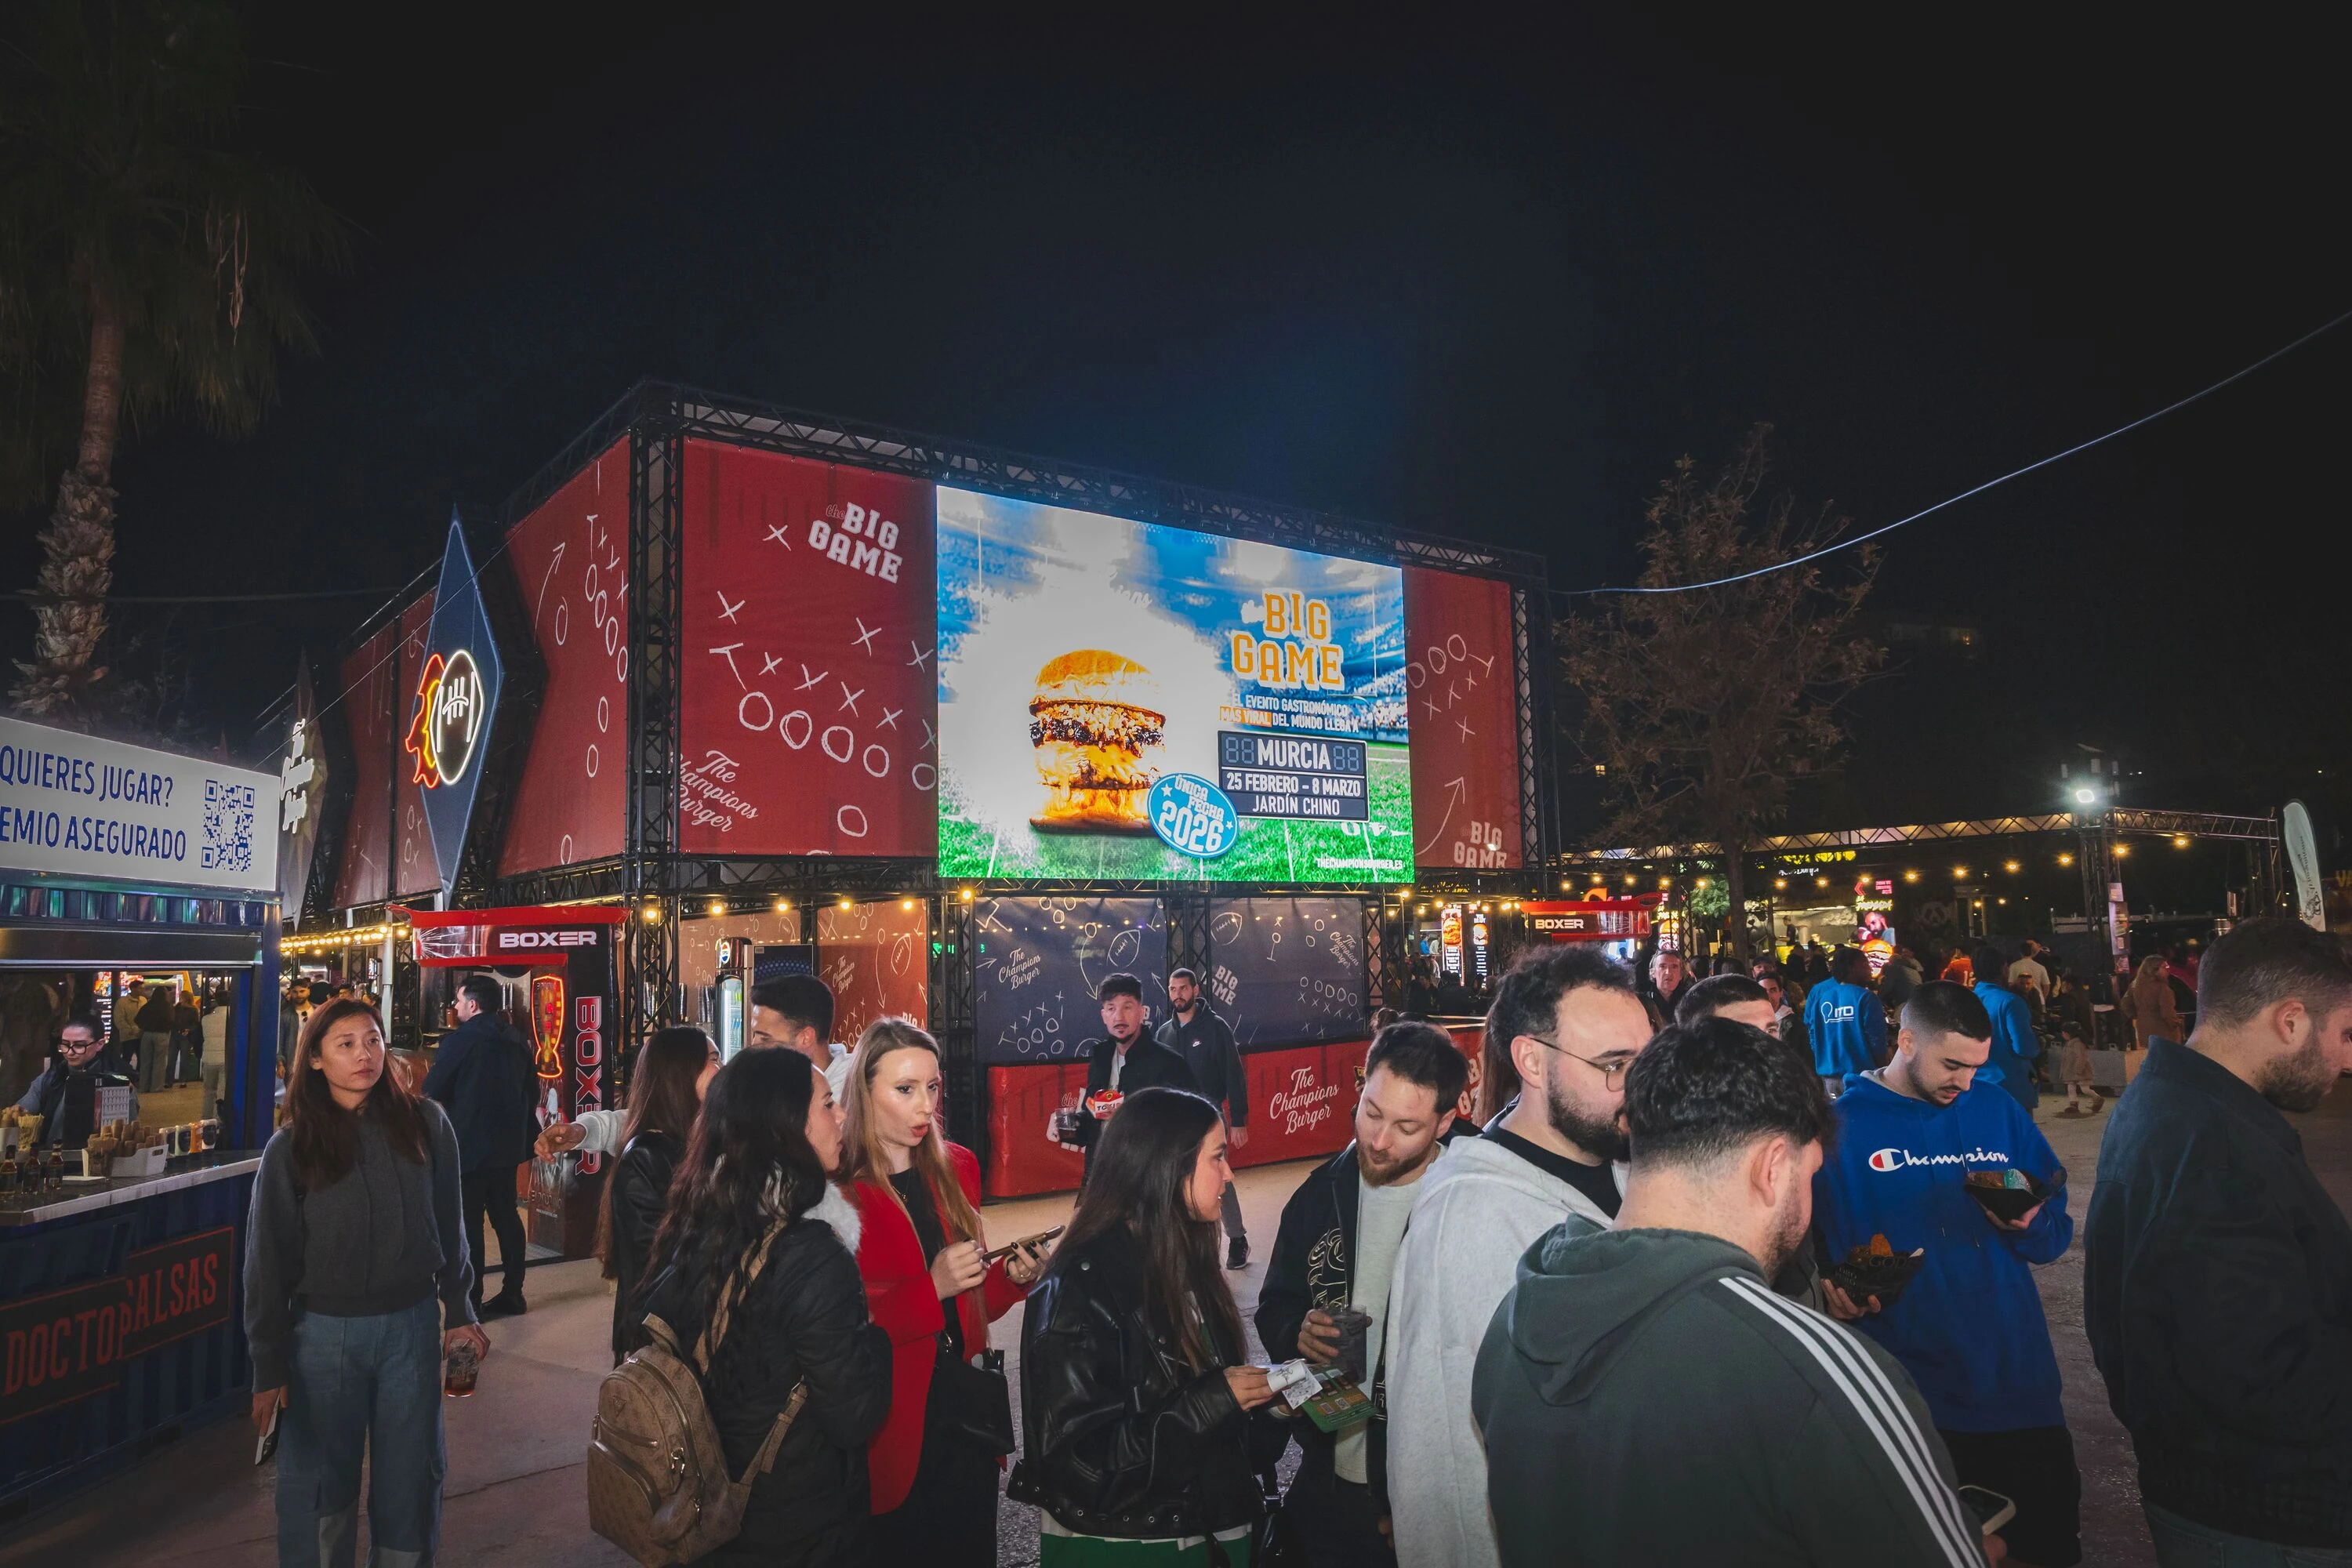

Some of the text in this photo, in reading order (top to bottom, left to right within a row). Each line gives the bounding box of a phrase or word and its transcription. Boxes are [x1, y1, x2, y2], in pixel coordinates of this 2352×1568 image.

[841, 502, 899, 550] BIG
[808, 520, 902, 583] GAME
[1263, 591, 1330, 643] BIG
[1232, 632, 1344, 690] GAME
[1245, 695, 1279, 711] EVENTO
[1272, 712, 1290, 727] DEL
[1290, 714, 1323, 730] MUNDO
[695, 750, 740, 783] The
[1257, 739, 1331, 770] MURCIA
[0, 745, 173, 808] QUIERES JUGAR?
[670, 752, 759, 819] hampions
[1226, 771, 1243, 790] 25
[1245, 773, 1299, 793] FEBRERO
[1312, 781, 1320, 795] 8
[1323, 780, 1361, 797] MARZO
[1186, 794, 1225, 822] FECHA
[1252, 793, 1340, 816] JARDÍN CHINO
[64, 815, 187, 862] ASEGURADO
[1158, 800, 1225, 852] 2026
[1469, 820, 1502, 851] BIG
[1454, 840, 1508, 869] GAME
[1535, 919, 1584, 929] BOXER
[499, 931, 597, 949] BOXER
[998, 954, 1041, 984] Champions
[1009, 947, 1025, 967] The
[1011, 966, 1040, 991] Burger
[1215, 965, 1239, 991] BIG
[1290, 1065, 1315, 1096] The
[1269, 1084, 1339, 1120] Champions
[1284, 1103, 1332, 1135] Burger
[1868, 1147, 2009, 1173] Champion
